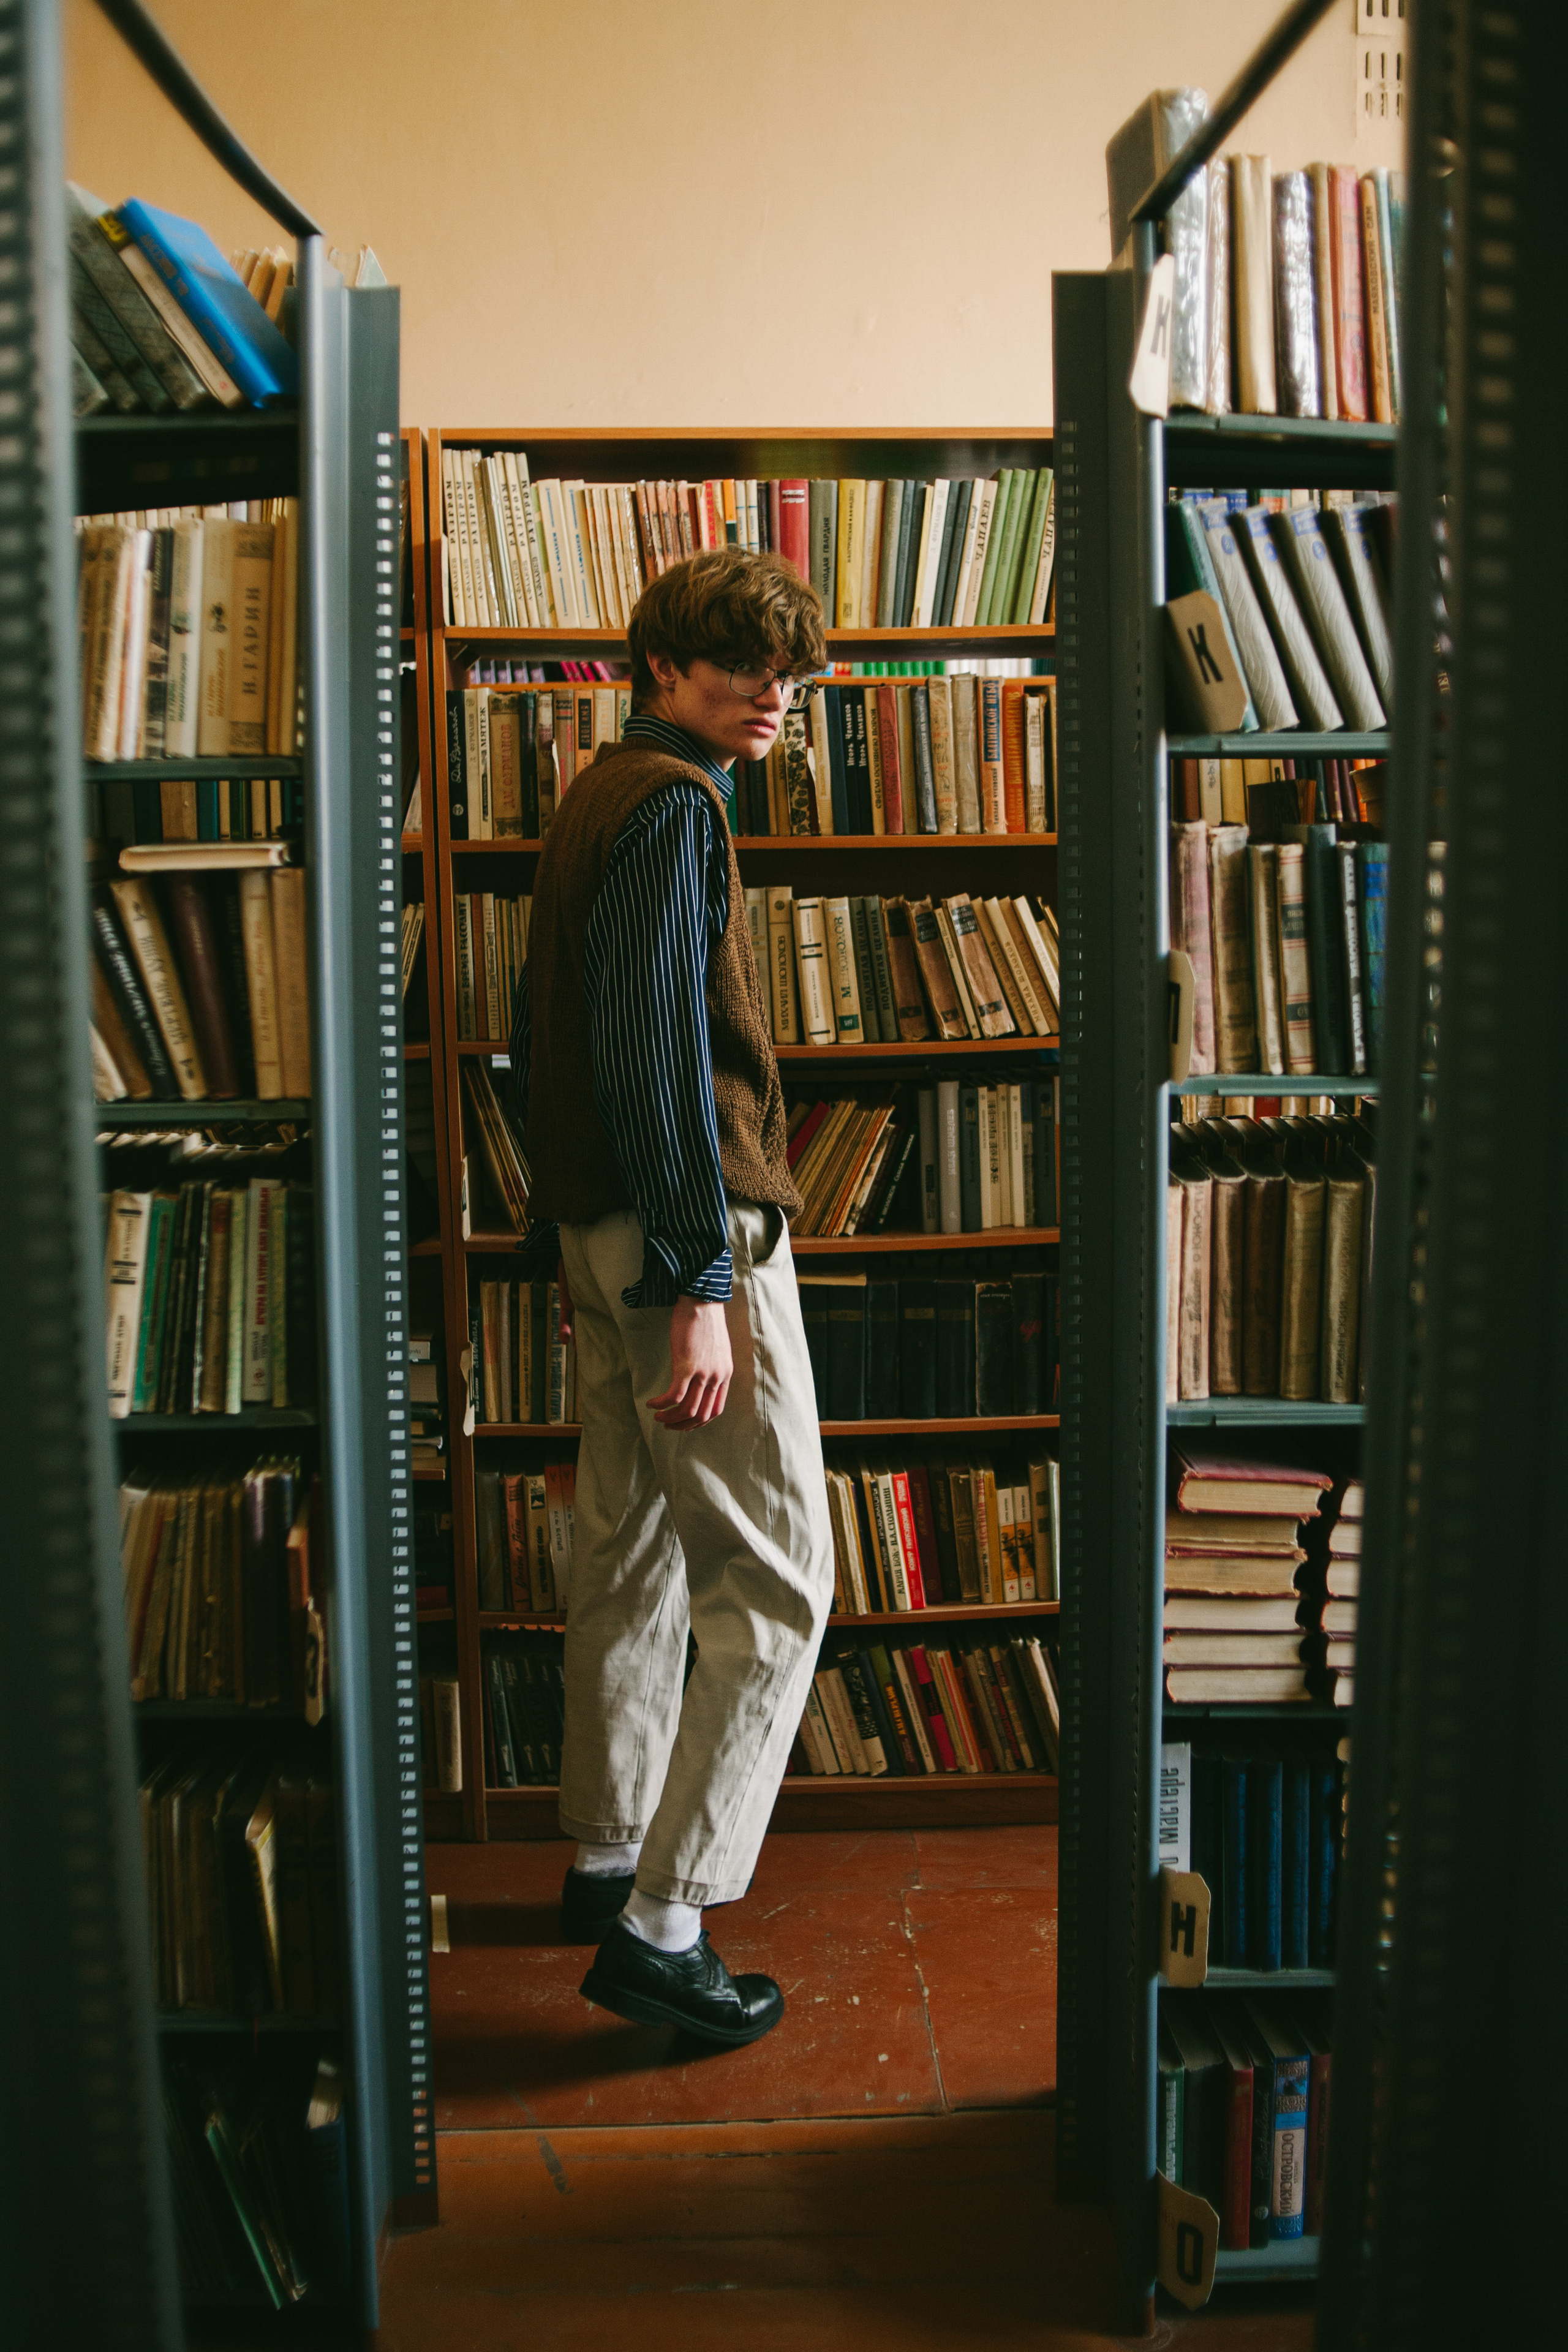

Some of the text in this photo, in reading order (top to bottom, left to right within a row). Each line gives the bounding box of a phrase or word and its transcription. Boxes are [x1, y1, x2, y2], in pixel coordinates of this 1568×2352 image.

[446, 480, 456, 544] РАЗГРОМ
[457, 481, 467, 545] РАЗГРОМ
[467, 481, 478, 545] РАЗГРОМ
[502, 482, 516, 546] РАЗГРОМ
[511, 483, 525, 547] РАЗГРОМ
[522, 479, 535, 543] РАЗГРОМ
[822, 516, 831, 553] ГВАРДИЯ
[975, 499, 991, 561] ЧАПАЕВ
[1187, 623, 1224, 685] К
[984, 682, 997, 704] НЕБО
[479, 706, 488, 748] МЯТЕЖ
[986, 707, 997, 760] БАЛТИЙСКОЕ
[777, 935, 790, 1031] МИХАИЛ ШОЛОХОВ
[856, 910, 875, 1012] ПОДНЯТАЯ ЦЕЛИНА
[870, 909, 891, 1011] ПОДНЯТАЯ ЦЕЛИНА
[1005, 941, 1041, 1023] МИХАИЛ ШОЛОХОВ
[1335, 1298, 1348, 1379] МЕДЫНСКИЙ
[890, 1550, 901, 1567] БОК
[893, 1569, 905, 1595] МАРИЯ
[1170, 1901, 1197, 1958] Н
[1280, 2132, 1295, 2215] ОСТРОВСКИЙ
